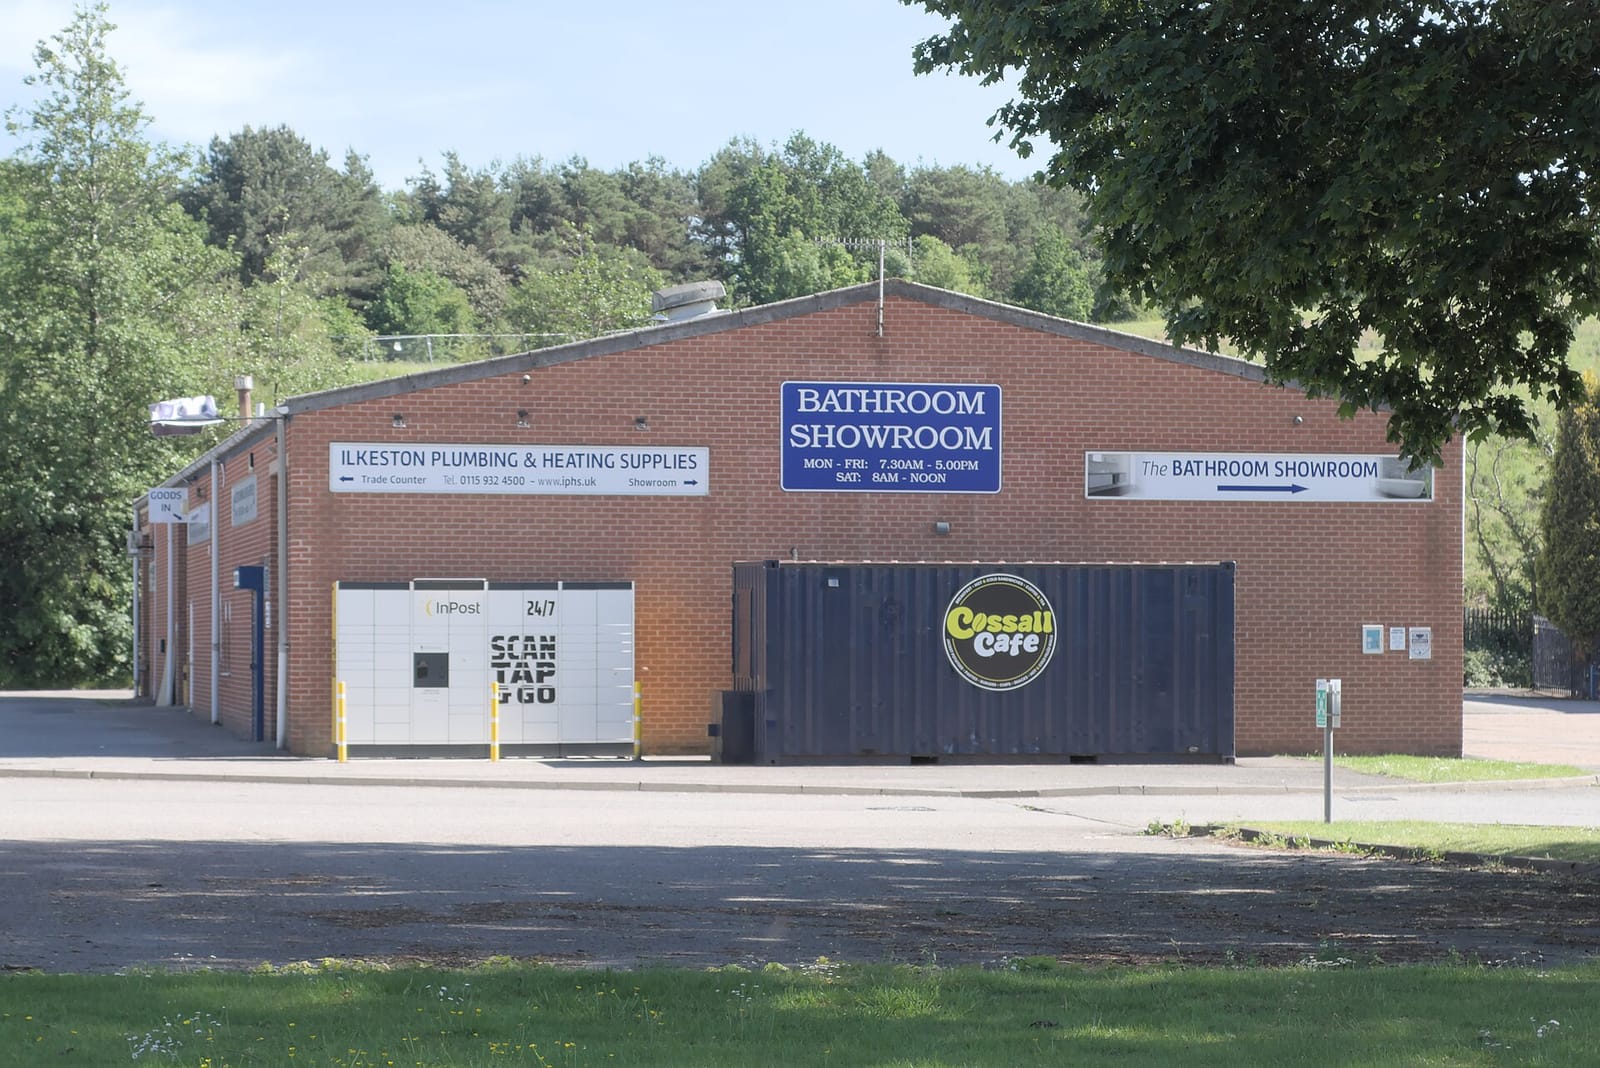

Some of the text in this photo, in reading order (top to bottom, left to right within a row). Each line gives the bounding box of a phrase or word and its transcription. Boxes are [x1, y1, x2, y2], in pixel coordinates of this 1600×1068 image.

[797, 388, 986, 415] BATHROOM
[789, 423, 993, 450] SHOWROOM
[341, 450, 697, 470] ILKESTON PLUMBING & HEATING SUPPLIES
[803, 458, 833, 469] MON
[844, 459, 868, 469] FRI:
[879, 459, 924, 470] 7.30AM
[935, 460, 979, 471] 5.00PM
[836, 472, 862, 482] SAT:
[872, 472, 899, 482] 8AM
[910, 473, 947, 483] NOON
[1142, 460, 1378, 478] The BATHROOM SHOWROOM
[361, 475, 427, 485] Trade Counter
[443, 475, 457, 485] Tel.
[460, 475, 480, 485] 0115
[483, 475, 499, 486] 932
[501, 476, 525, 486] 4500
[538, 476, 597, 487] www.iphs.uk
[629, 478, 677, 487] Showroom
[150, 490, 182, 500] GOODS
[161, 503, 171, 512] IN
[436, 601, 480, 614] InPost
[527, 600, 555, 617] 24/7
[946, 606, 1053, 639] Cossall
[491, 635, 556, 660] SCAN
[974, 631, 1039, 657] Cafe
[491, 662, 556, 684] TAP
[516, 685, 556, 704] GO
